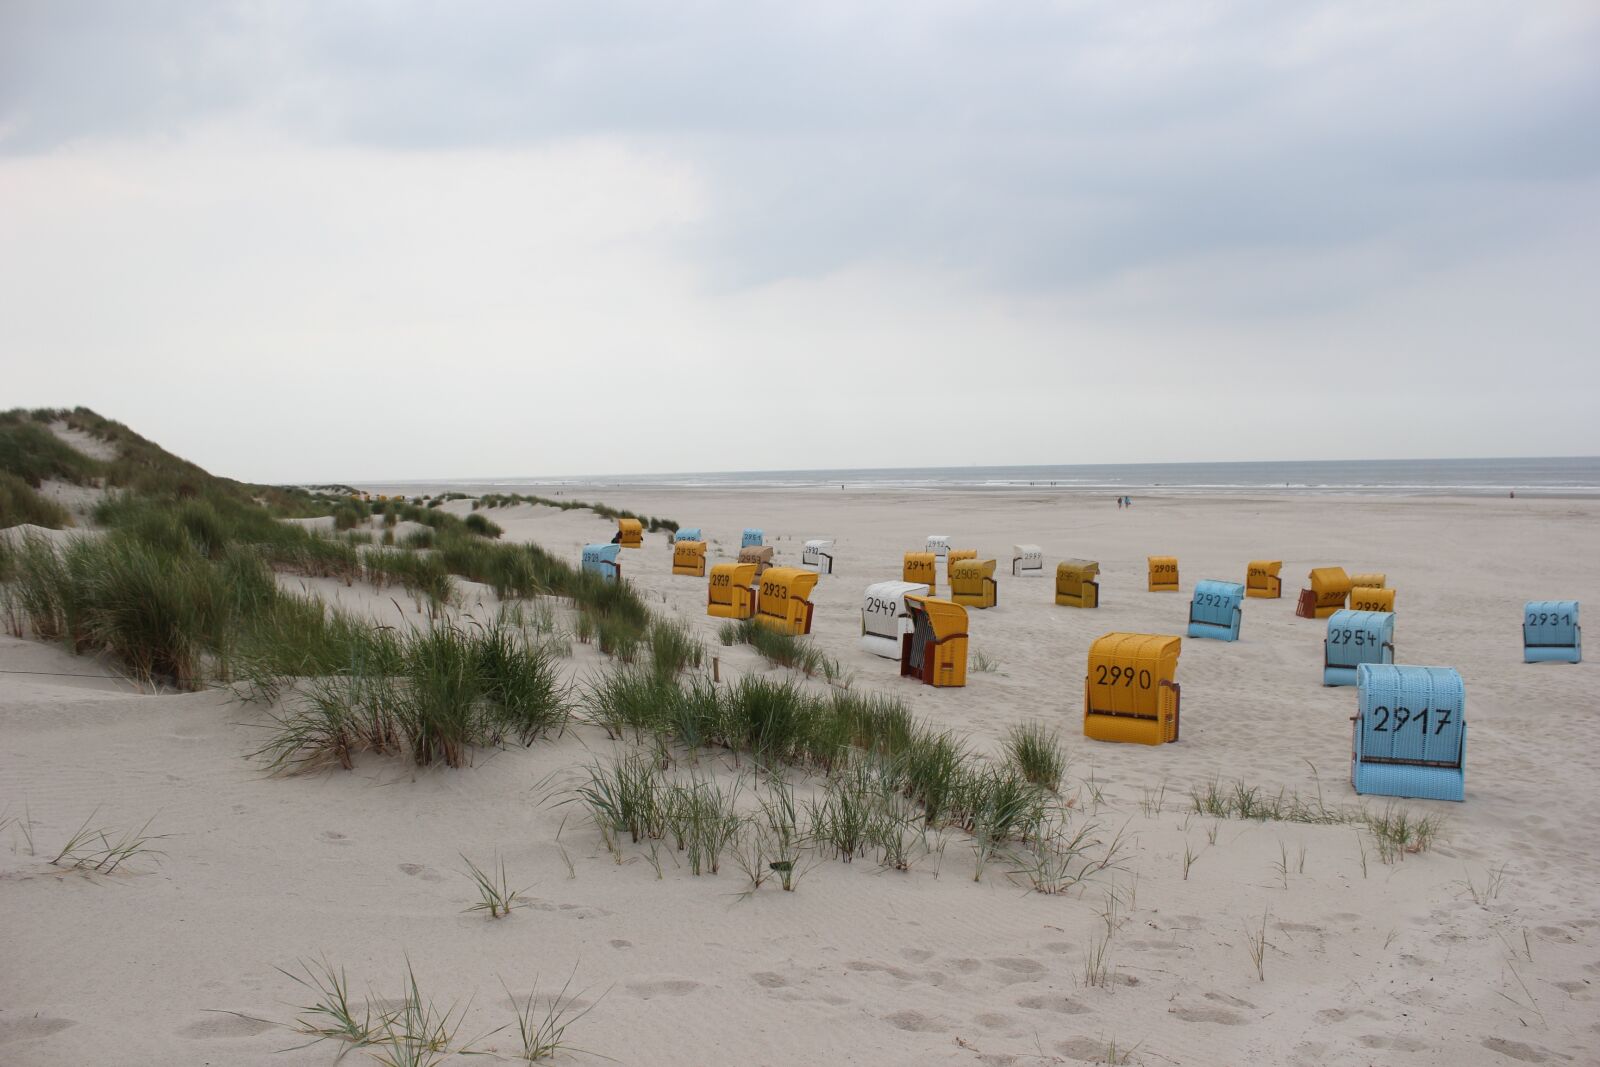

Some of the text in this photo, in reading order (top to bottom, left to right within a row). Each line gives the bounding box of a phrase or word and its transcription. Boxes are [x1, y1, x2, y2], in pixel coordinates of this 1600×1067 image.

[1153, 564, 1176, 574] 2908
[763, 582, 787, 600] 2933
[866, 596, 896, 617] 2949
[1196, 593, 1230, 609] 2927
[1528, 613, 1571, 627] 2931
[1331, 628, 1377, 647] 2954
[1096, 664, 1152, 690] 2990
[1373, 705, 1452, 735] 2917
